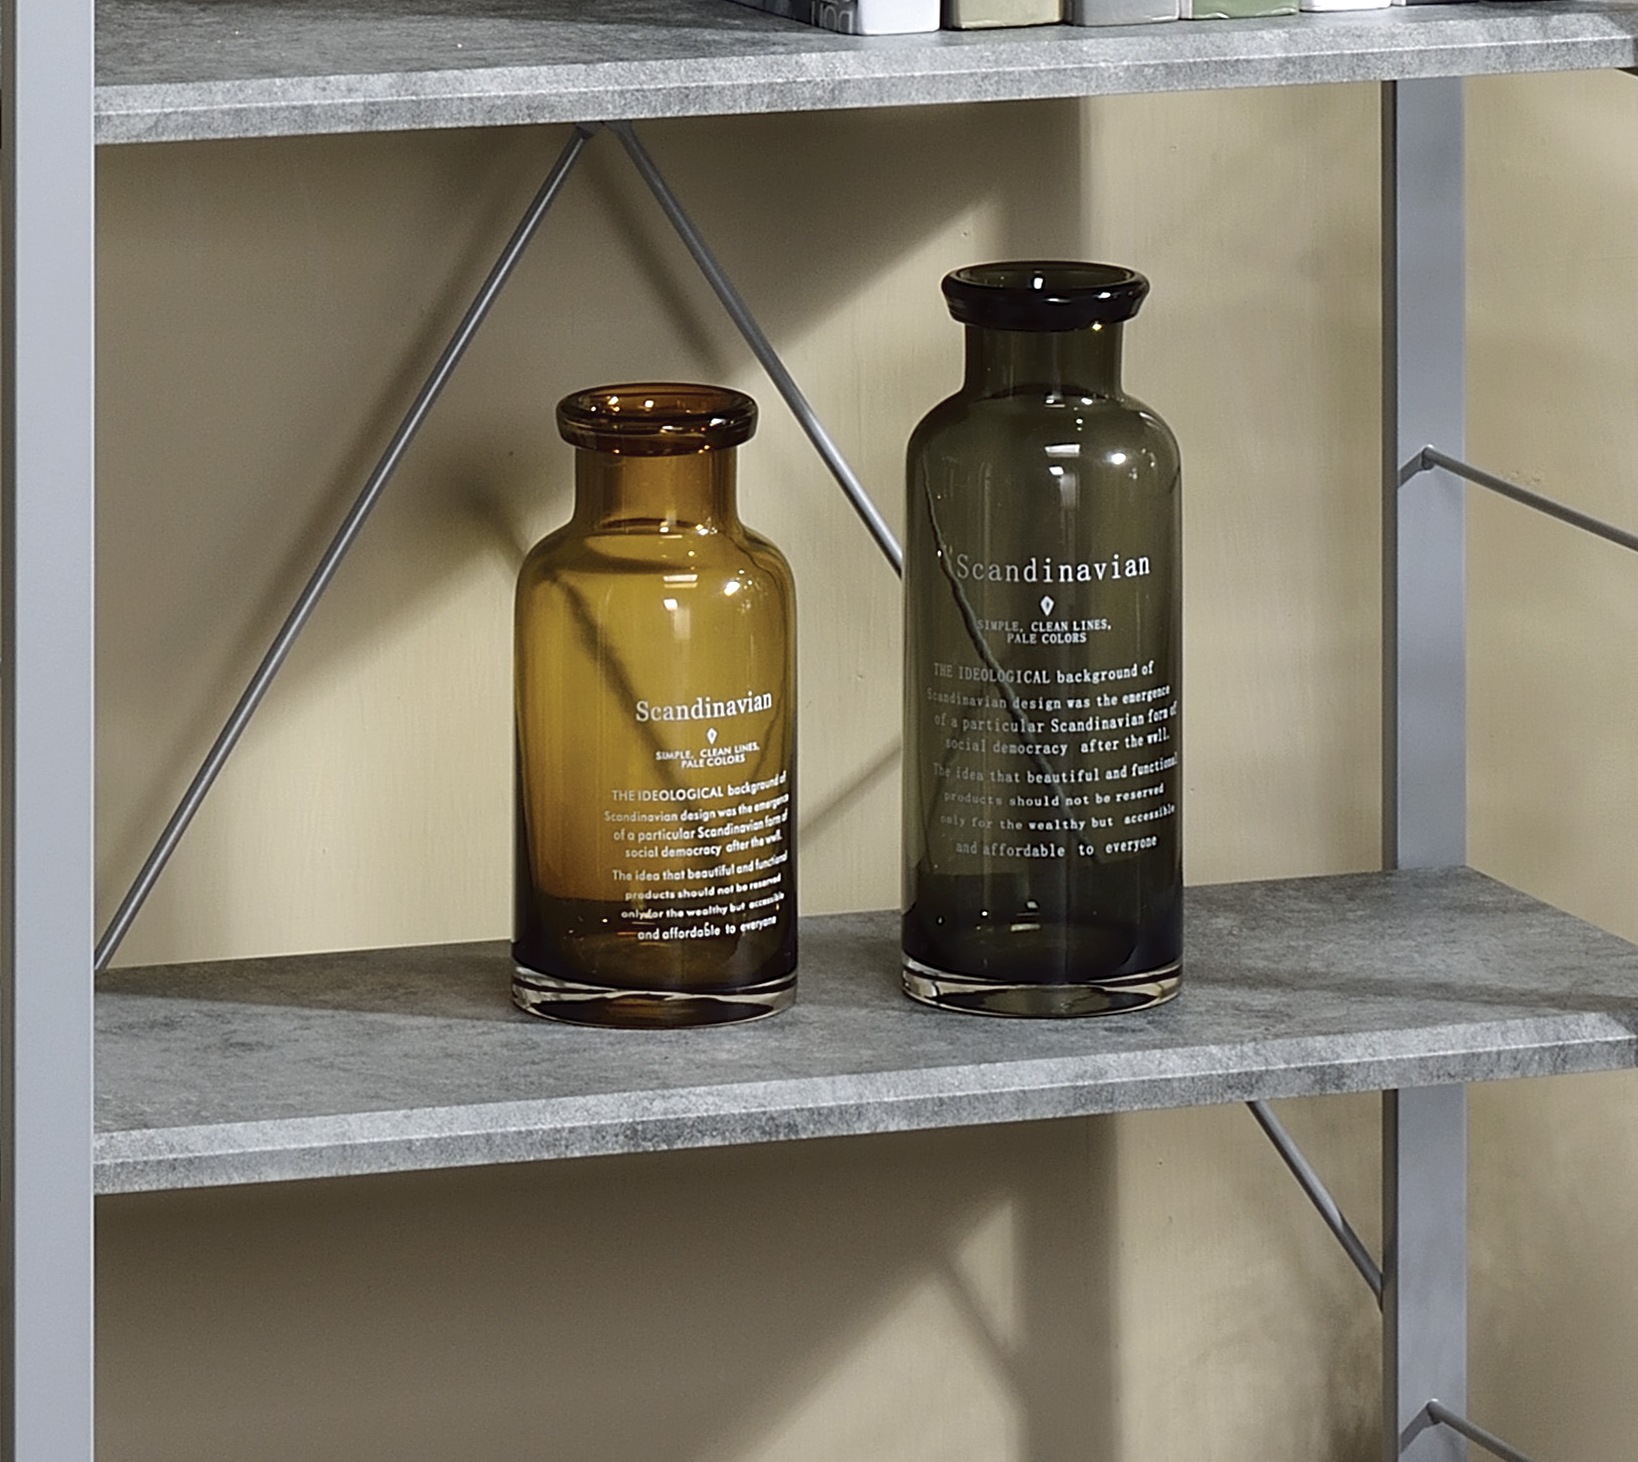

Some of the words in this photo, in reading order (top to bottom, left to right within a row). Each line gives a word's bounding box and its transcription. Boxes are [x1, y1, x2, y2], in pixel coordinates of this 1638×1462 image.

[956, 552, 1151, 583] Scandinavian
[1006, 632, 1037, 644] PALE
[1041, 631, 1088, 644] COLORS
[1030, 621, 1069, 633] CLEAN
[933, 662, 954, 679] THE
[958, 665, 1051, 685] IDEOLOGICAL
[1056, 664, 1138, 685] background
[1141, 660, 1155, 675] of
[635, 690, 773, 723] Scandinavian
[926, 687, 1007, 709] Scandinavian
[1012, 696, 1062, 712] design
[1066, 696, 1091, 709] was
[1096, 693, 1118, 707] the
[1121, 684, 1171, 704] emergence
[933, 713, 947, 727] of
[962, 718, 1045, 734] particular
[1050, 713, 1145, 734] Scandinavian
[1147, 708, 1169, 724] form
[699, 747, 732, 759] CLEAN
[945, 737, 986, 752] social
[992, 739, 1069, 757] democracy
[1080, 738, 1119, 754] after
[1124, 733, 1144, 749] the
[680, 758, 705, 769] PALE
[706, 753, 746, 767] COLORS
[933, 762, 951, 777] The
[955, 766, 984, 781] idea
[989, 769, 1021, 783] that
[1026, 768, 1100, 784] beautiful
[1105, 767, 1128, 781] and
[611, 789, 636, 802] THE
[637, 785, 724, 802] IDEOLOGICAL
[727, 773, 779, 797] background
[943, 791, 1003, 807] products
[1008, 793, 1060, 807] should
[1064, 794, 1090, 807] not
[1095, 793, 1111, 805] be
[1115, 782, 1165, 803] reserved
[603, 810, 678, 823] Scandinavian
[679, 808, 716, 823] design
[717, 807, 737, 819] was
[737, 803, 753, 815] the
[939, 814, 965, 828] only
[971, 816, 993, 829] for
[999, 818, 1023, 831] the
[1028, 819, 1086, 832] wealthy
[1091, 816, 1113, 828] but
[1123, 803, 1176, 825] accessible
[613, 828, 626, 841] of
[627, 831, 635, 841] a
[637, 827, 695, 844] particular
[697, 818, 764, 839] Scandinavian
[764, 814, 781, 828] form
[625, 846, 659, 858] social
[660, 844, 723, 858] democracy
[725, 838, 749, 853] after
[750, 834, 764, 847] the
[955, 840, 978, 854] and
[982, 842, 1065, 857] affordable
[1078, 842, 1095, 857] to
[1105, 834, 1158, 854] everyone
[612, 869, 633, 882] The
[635, 869, 660, 882] idea
[662, 869, 686, 881] that
[687, 863, 735, 881] beautiful
[736, 860, 754, 874] and
[625, 888, 675, 902] products
[677, 887, 715, 900] should
[716, 883, 735, 895] not
[735, 882, 749, 893] be
[749, 872, 782, 891] reserved
[620, 908, 644, 921] only
[665, 907, 685, 919] the
[686, 903, 728, 917] wealthy
[729, 901, 746, 912] but
[637, 928, 660, 941] and
[662, 922, 721, 940] affordable
[724, 923, 737, 935] to
[739, 915, 777, 933] everyone
